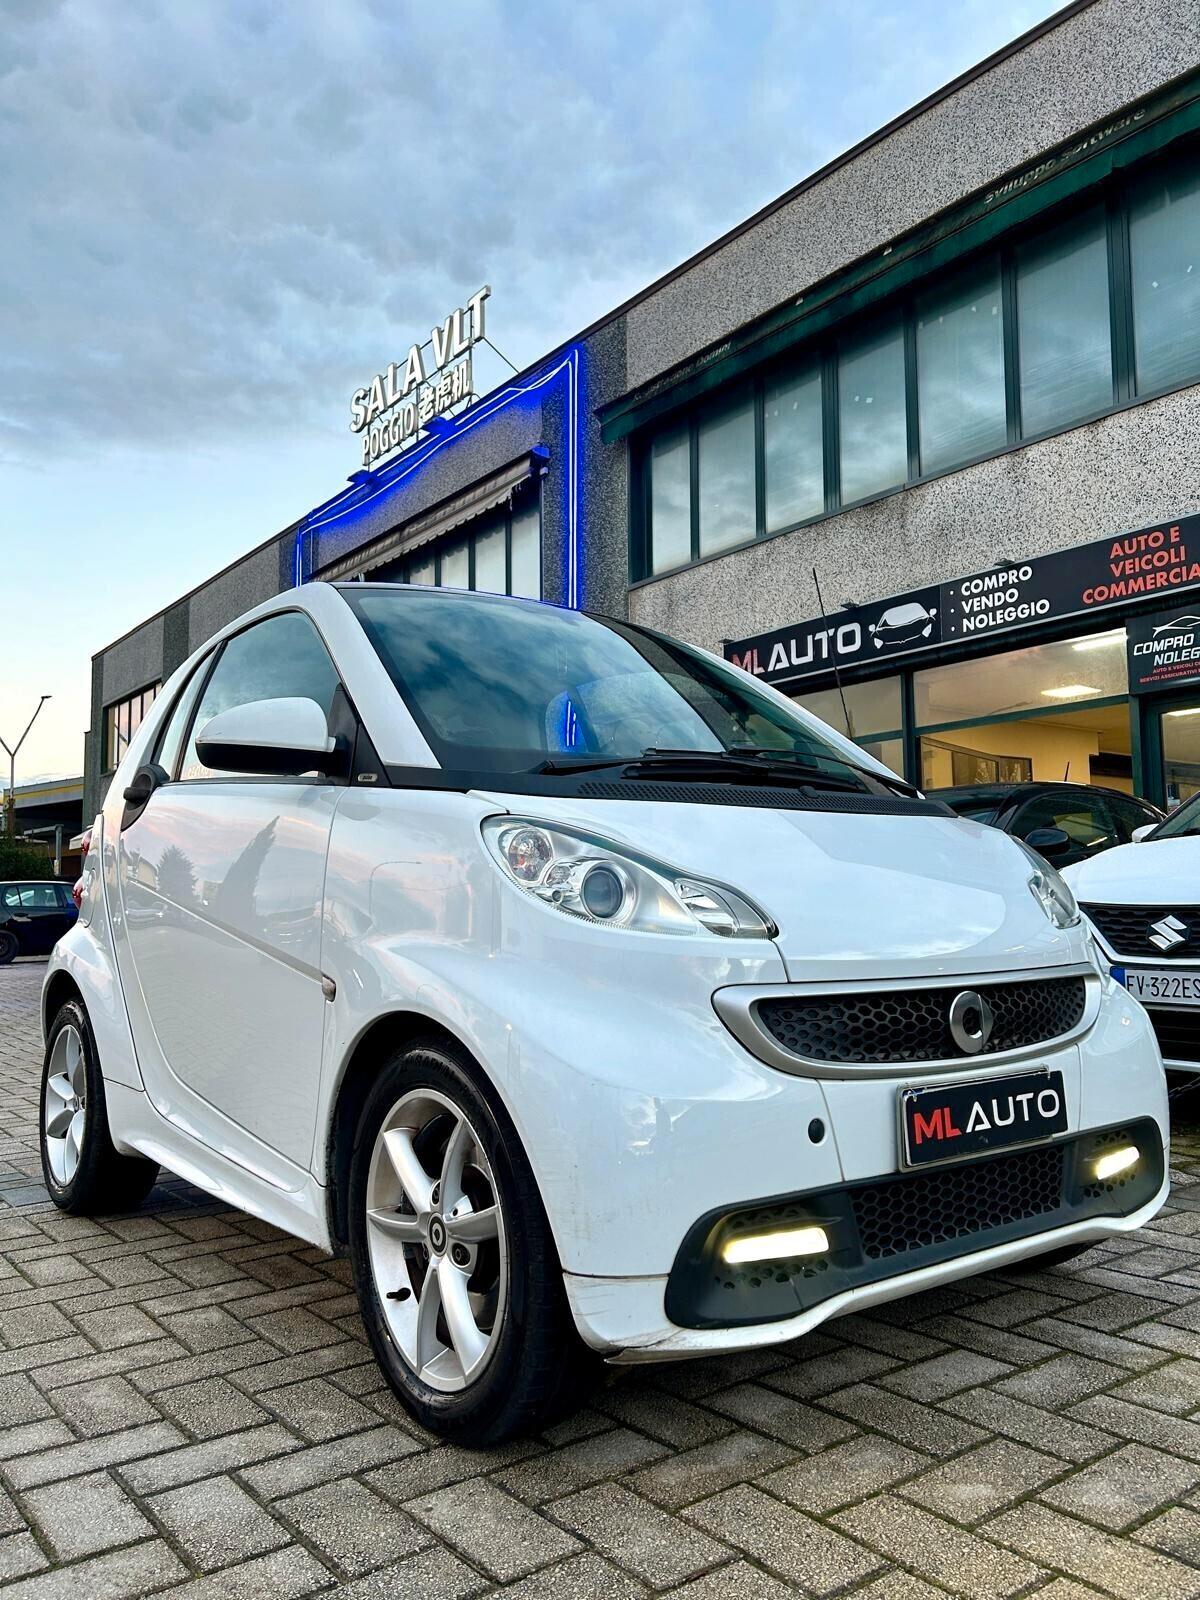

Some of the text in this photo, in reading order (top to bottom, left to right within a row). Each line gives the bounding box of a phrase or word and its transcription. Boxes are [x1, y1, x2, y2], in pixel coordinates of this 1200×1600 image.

[350, 284, 491, 433] SALA VLT
[417, 359, 473, 422] 老虎机
[362, 401, 418, 466] POGGIO
[1110, 526, 1181, 559] AUTO E
[1109, 545, 1186, 578] VEICOLI
[960, 566, 1033, 596] COMPRO
[1082, 563, 1200, 605] COMMERCIA
[960, 588, 1019, 615] VENDO
[962, 599, 1050, 633] NOLEGGIO
[767, 622, 862, 672] AUTO
[1133, 633, 1195, 656] COMPRO
[1153, 646, 1200, 667] NOLEG
[1160, 669, 1198, 679] ASSICURATIVI
[913, 1088, 1060, 1145] ML AUTO
